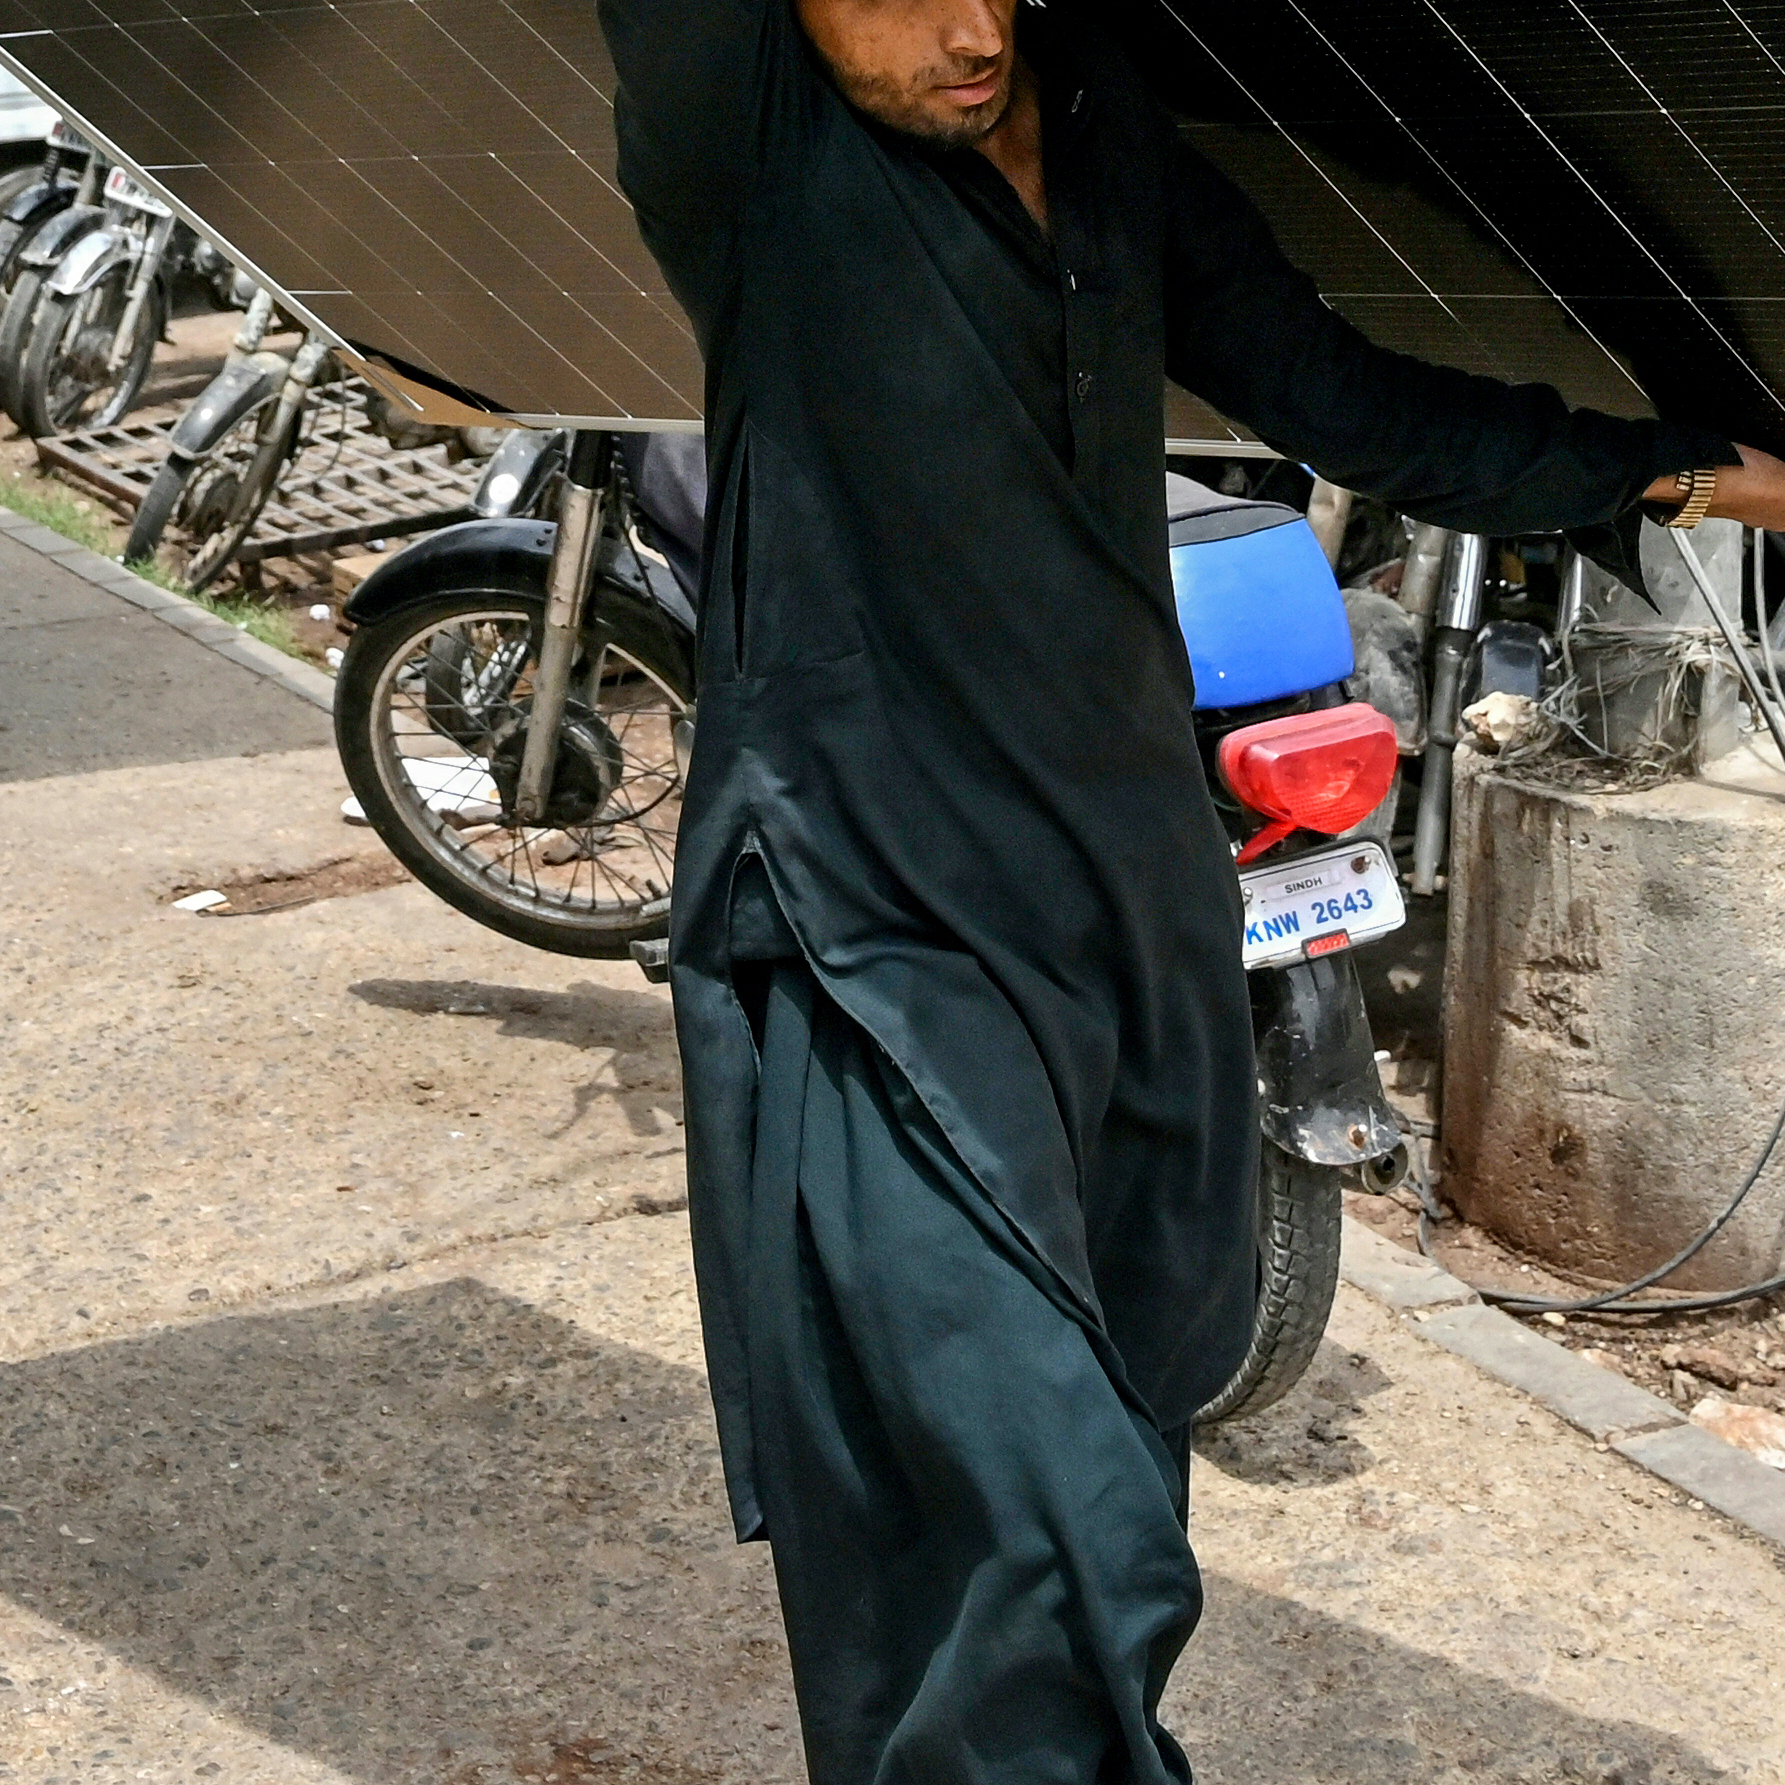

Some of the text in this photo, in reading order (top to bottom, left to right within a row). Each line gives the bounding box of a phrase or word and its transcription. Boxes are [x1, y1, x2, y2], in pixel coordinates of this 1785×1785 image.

[1284, 876, 1324, 895] SINDH
[1245, 888, 1374, 946] KNW 2643
